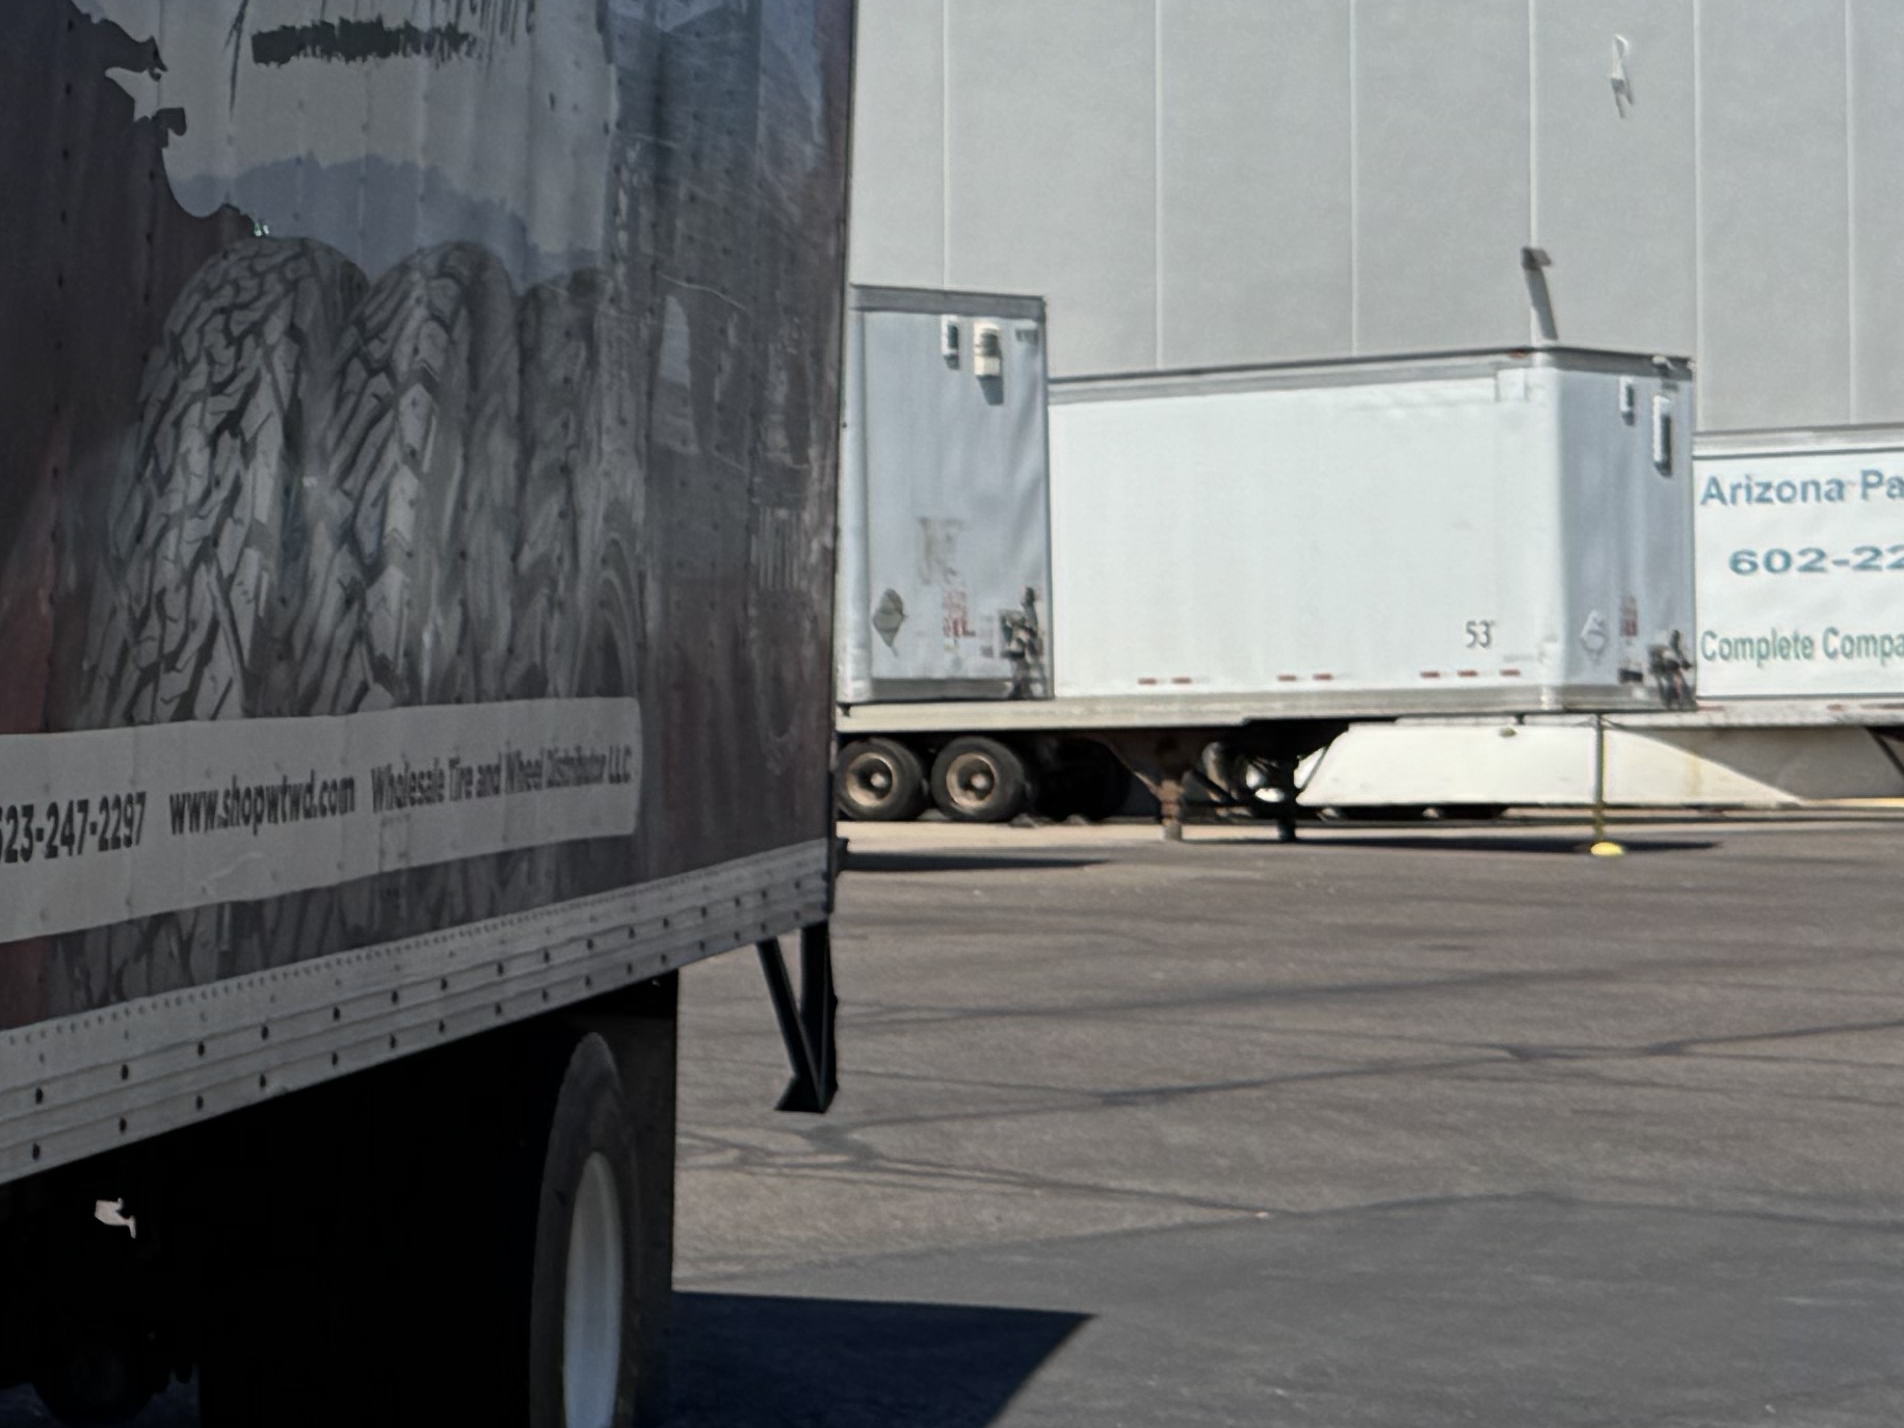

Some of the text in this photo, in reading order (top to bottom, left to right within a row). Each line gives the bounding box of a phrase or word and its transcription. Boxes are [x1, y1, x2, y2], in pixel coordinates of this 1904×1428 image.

[1700, 473, 1846, 506] Arizona
[1701, 627, 1815, 668] Complete
[169, 768, 355, 836] www.shopwtwd.com
